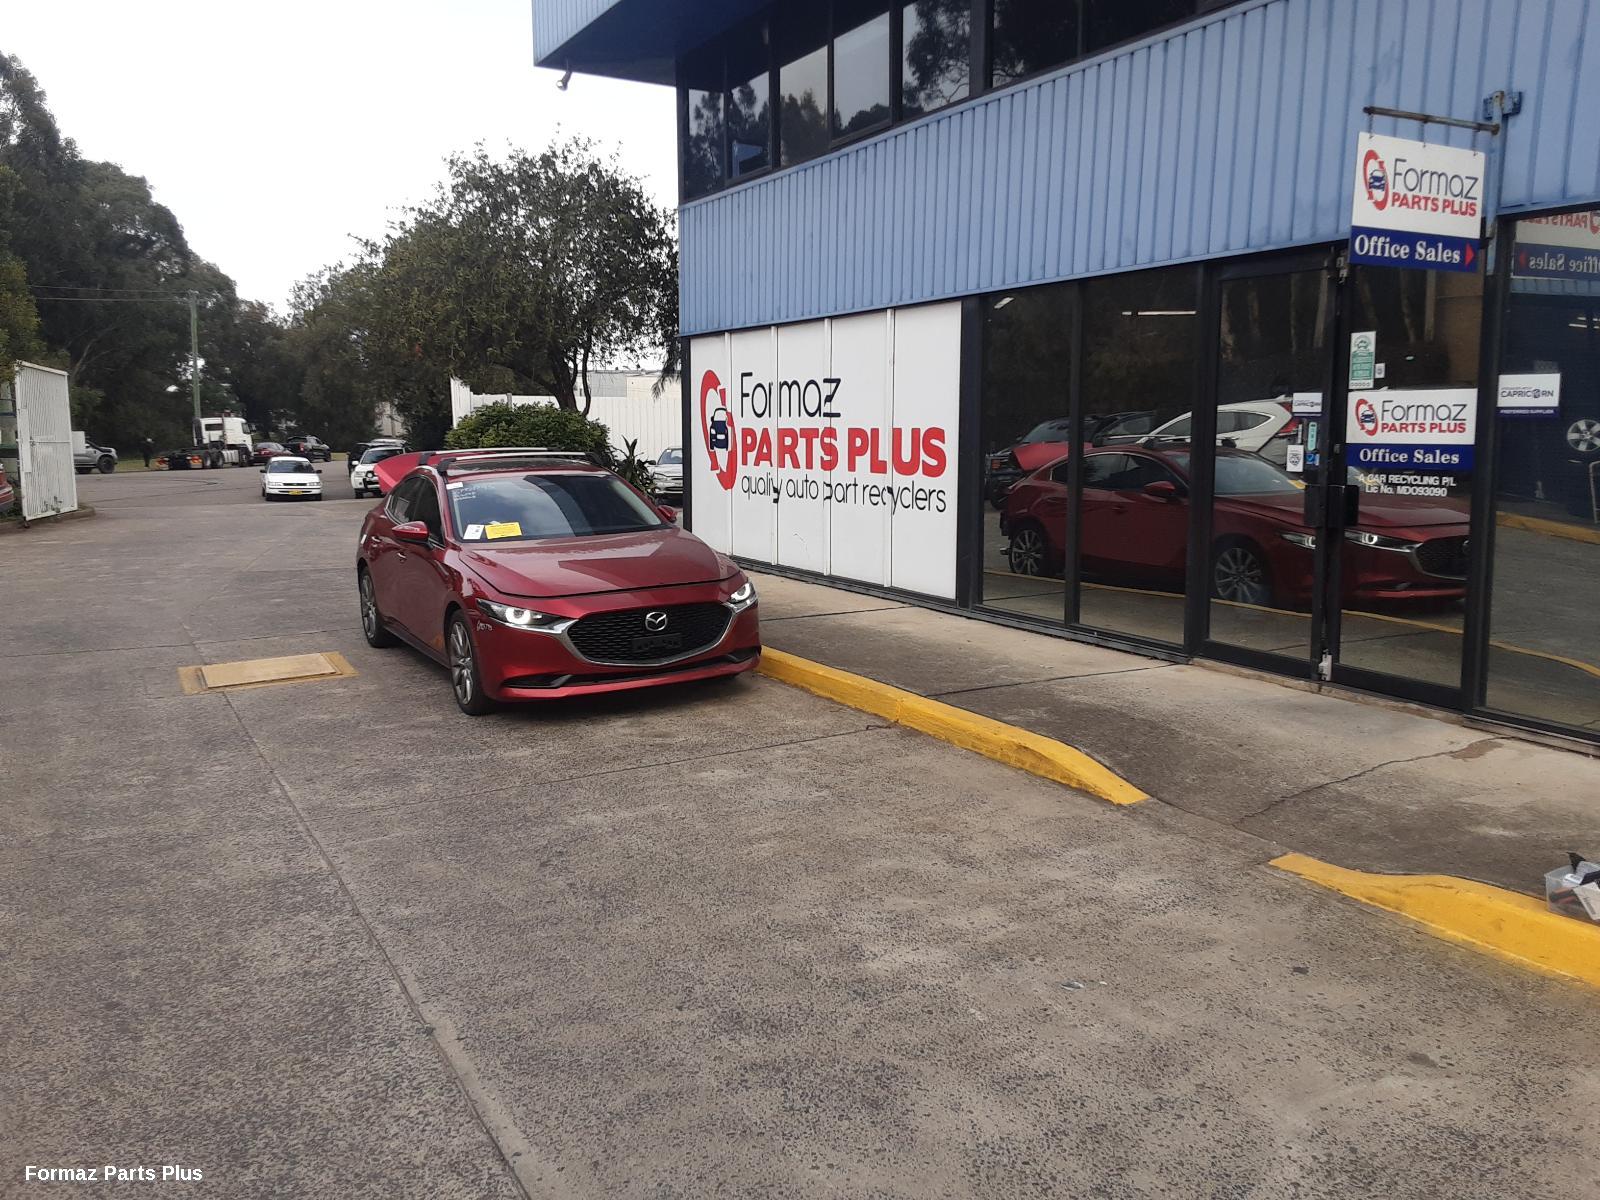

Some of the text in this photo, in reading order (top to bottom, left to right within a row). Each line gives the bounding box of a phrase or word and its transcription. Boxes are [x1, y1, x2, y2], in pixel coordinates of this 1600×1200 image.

[1393, 158, 1479, 200] Formaz
[1391, 192, 1477, 217] PARTS PLUS
[1354, 234, 1461, 263] Office Sales
[741, 371, 842, 418] Formaz
[1381, 399, 1468, 421] Formaz
[1381, 422, 1467, 433] PARTS PLUS
[741, 427, 947, 478] PARTS PLUS
[1359, 448, 1460, 464] Office Sales
[1367, 473, 1387, 483] CAR
[1388, 474, 1440, 486] RECYCLING
[786, 473, 819, 500] auto
[823, 477, 858, 509] part
[862, 480, 947, 516] recyclers
